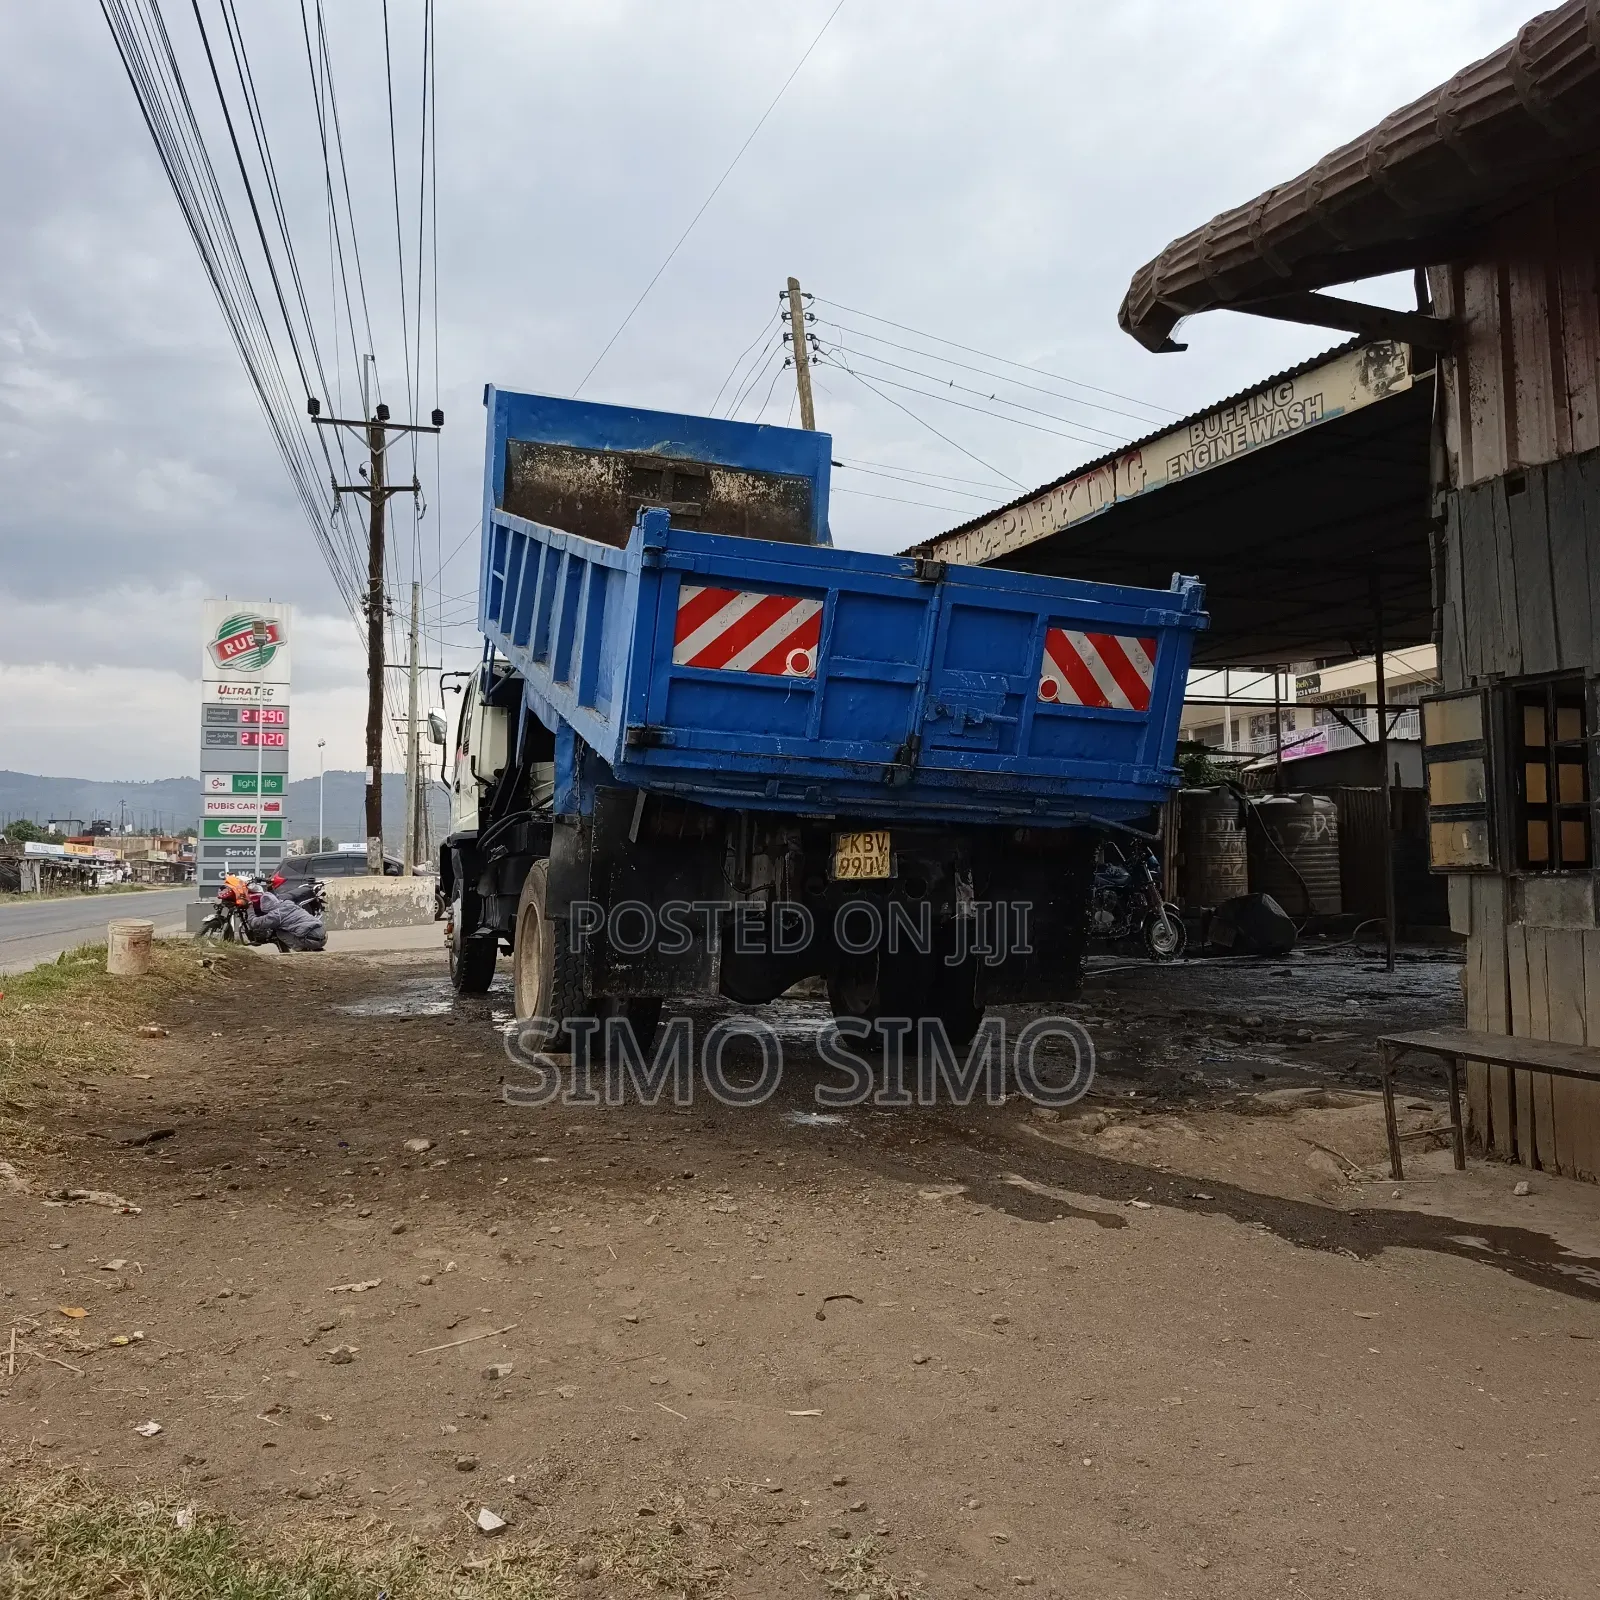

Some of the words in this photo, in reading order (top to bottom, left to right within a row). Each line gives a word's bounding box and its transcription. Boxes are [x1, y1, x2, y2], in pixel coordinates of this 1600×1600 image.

[1188, 380, 1294, 447] BUFFING
[1166, 425, 1248, 483] ENGINE
[1250, 392, 1324, 445] WASH
[998, 449, 1148, 550] PARKING
[224, 628, 273, 655] RUBS
[238, 779, 256, 789] light
[264, 779, 277, 788] life
[850, 832, 886, 854] KBV
[238, 870, 266, 879] Wah
